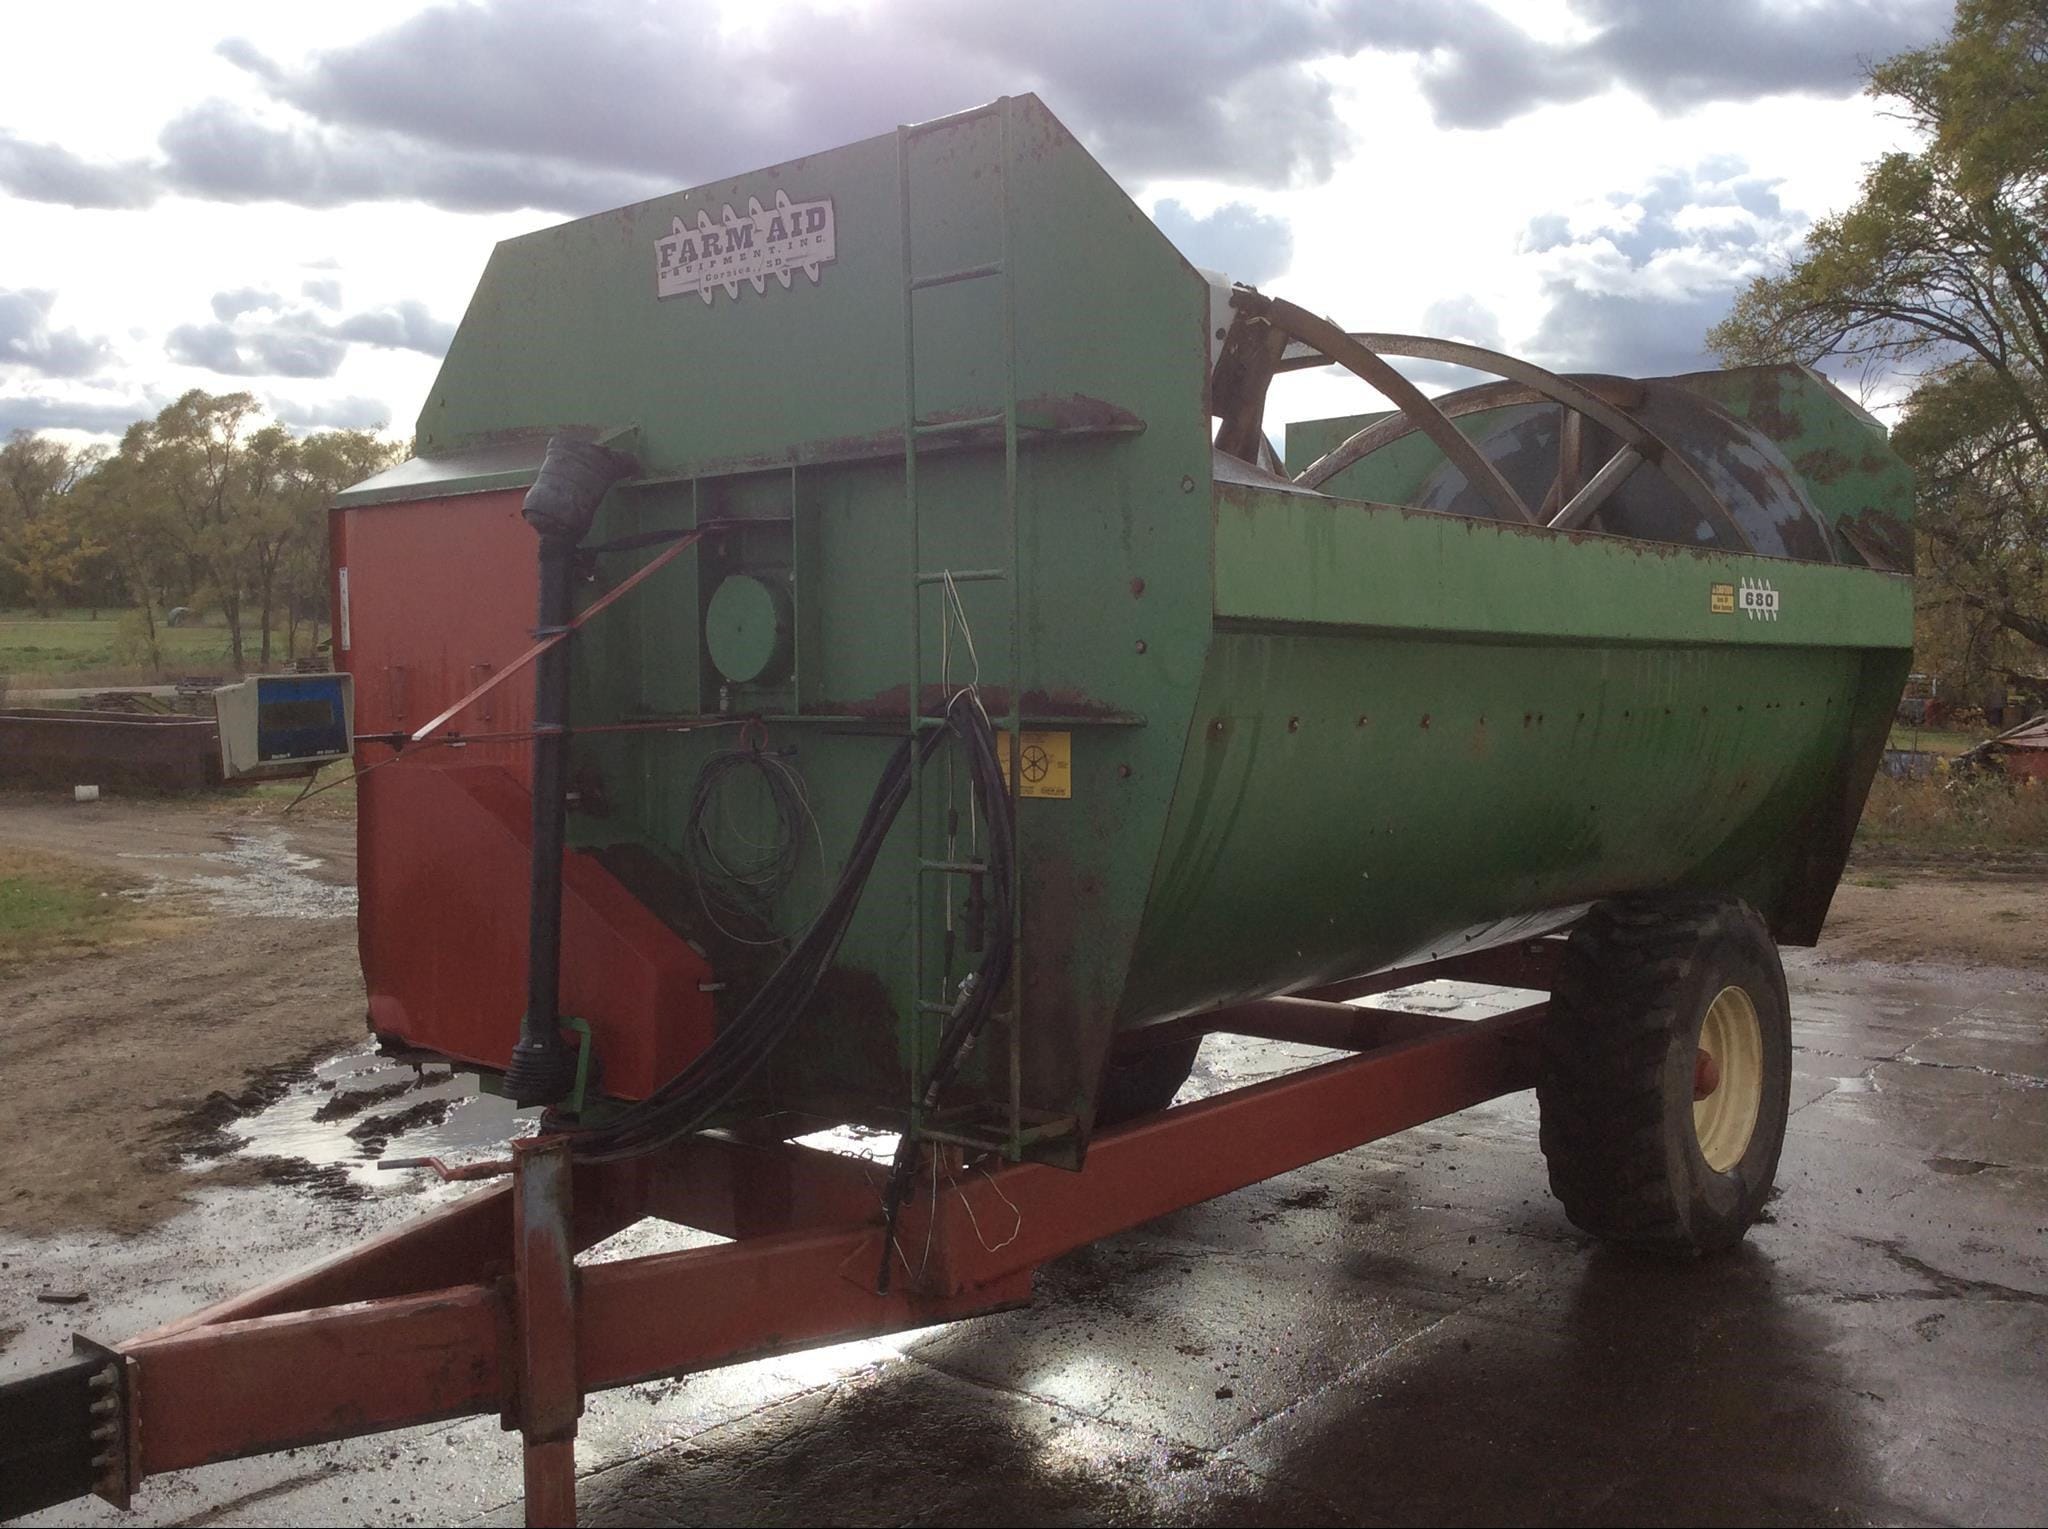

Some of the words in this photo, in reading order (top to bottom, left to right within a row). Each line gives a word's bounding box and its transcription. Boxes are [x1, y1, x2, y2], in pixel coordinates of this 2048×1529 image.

[660, 223, 754, 268] FARM
[766, 206, 826, 244] AID
[766, 257, 782, 268] SD
[1745, 591, 1774, 608] 680
